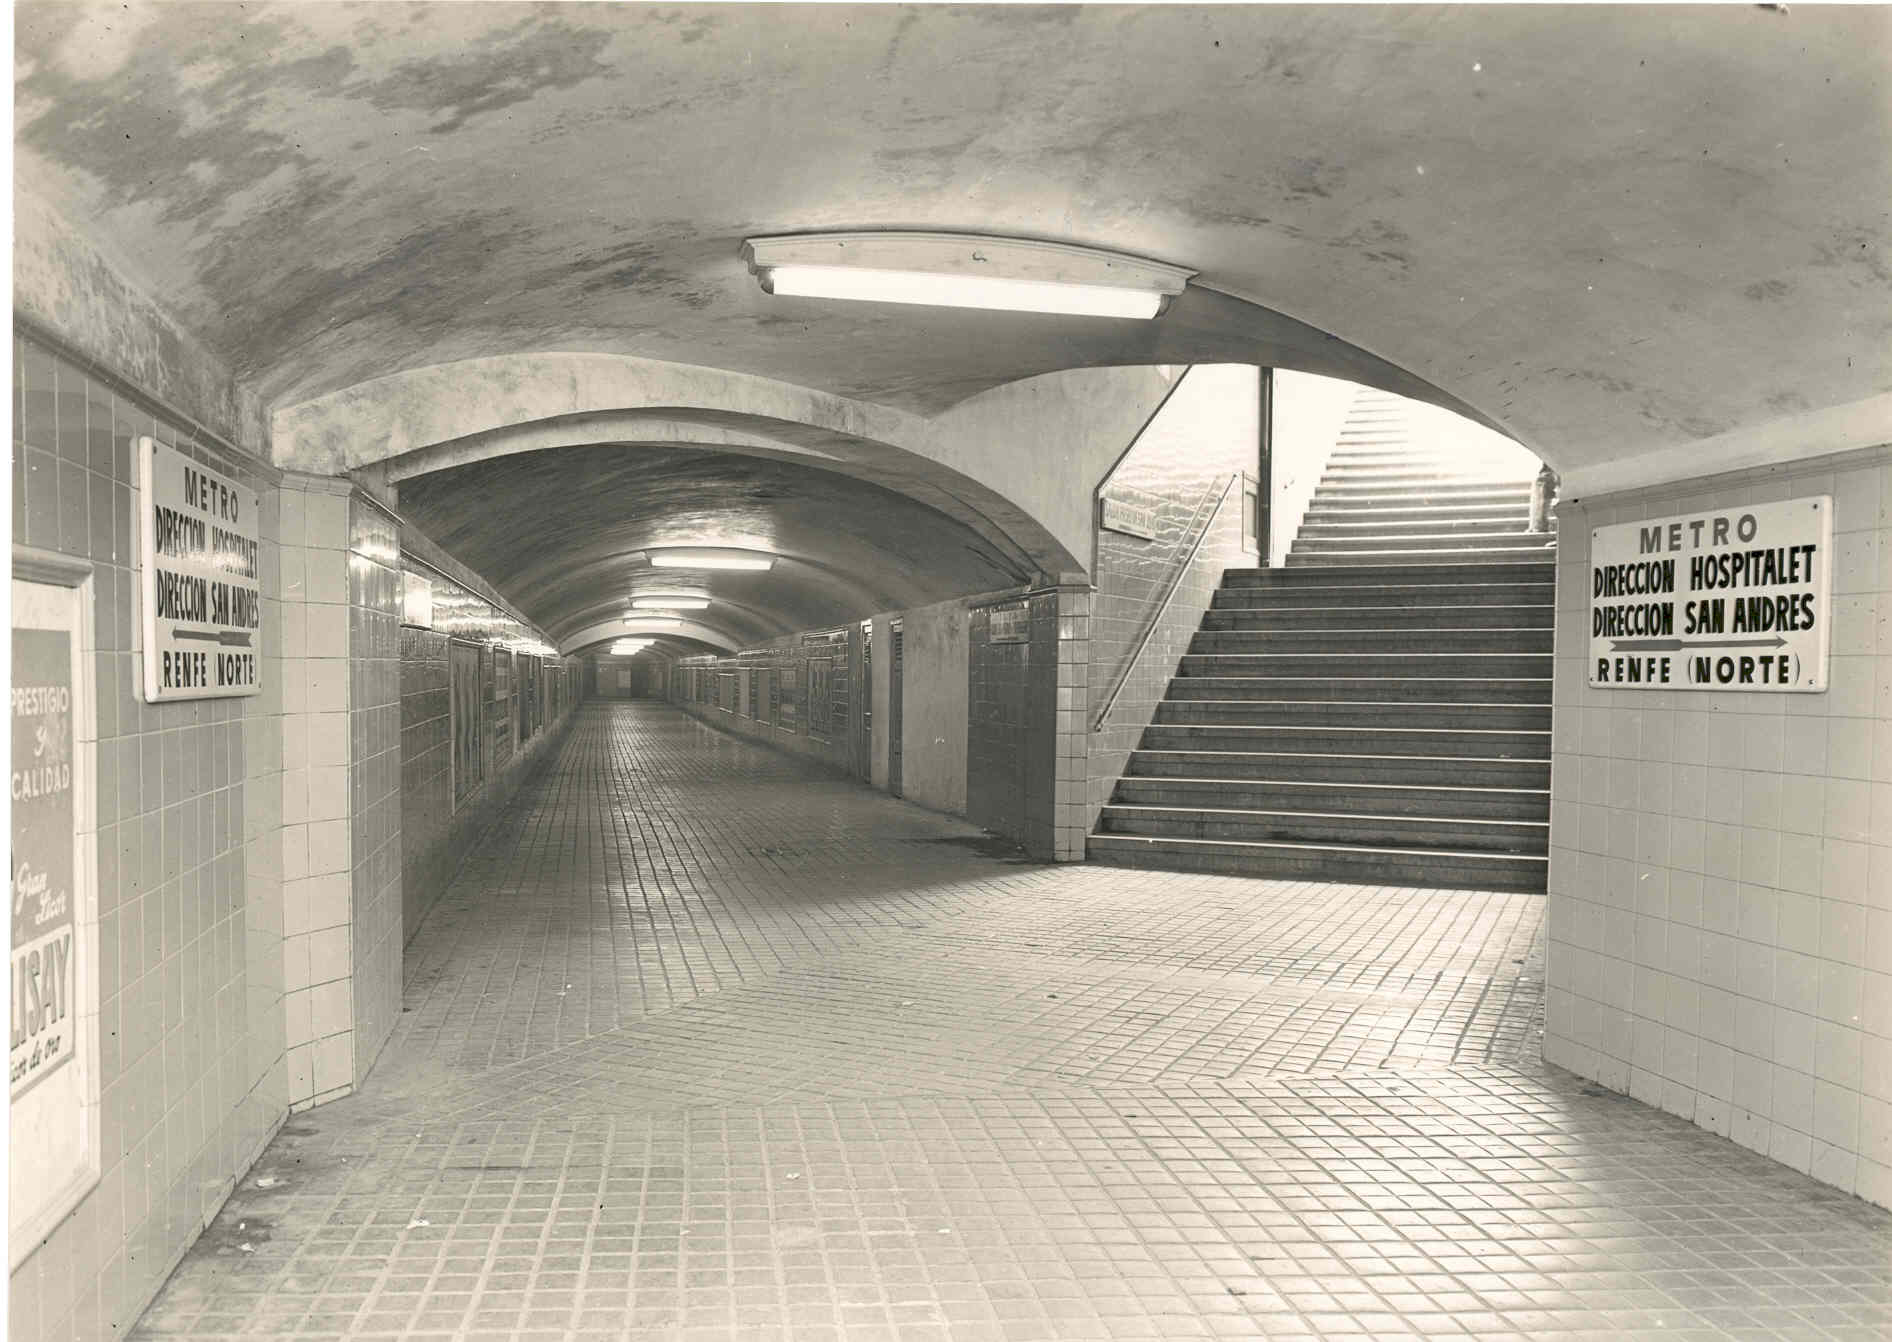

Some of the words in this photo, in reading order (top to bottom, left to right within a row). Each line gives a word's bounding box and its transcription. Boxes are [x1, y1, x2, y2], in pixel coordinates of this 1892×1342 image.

[184, 466, 238, 523] METRO
[155, 504, 206, 559] DIRECCION
[1639, 513, 1758, 554] METRO
[1593, 559, 1675, 599] DIRECCION
[1689, 544, 1817, 591] HOSPITALET
[156, 568, 207, 623] DIRECCION
[211, 581, 229, 626] SAN
[231, 585, 259, 629] ANDRES
[1592, 601, 1674, 638] DIRECCION
[1684, 598, 1725, 635] SAN
[1732, 593, 1815, 634] ANDRES
[163, 650, 206, 688] RENFE
[1597, 657, 1671, 683] RENFE
[1687, 652, 1801, 687] (NORTE)
[11, 686, 69, 717] PRESTIGIO
[12, 763, 70, 801] CALIDAD
